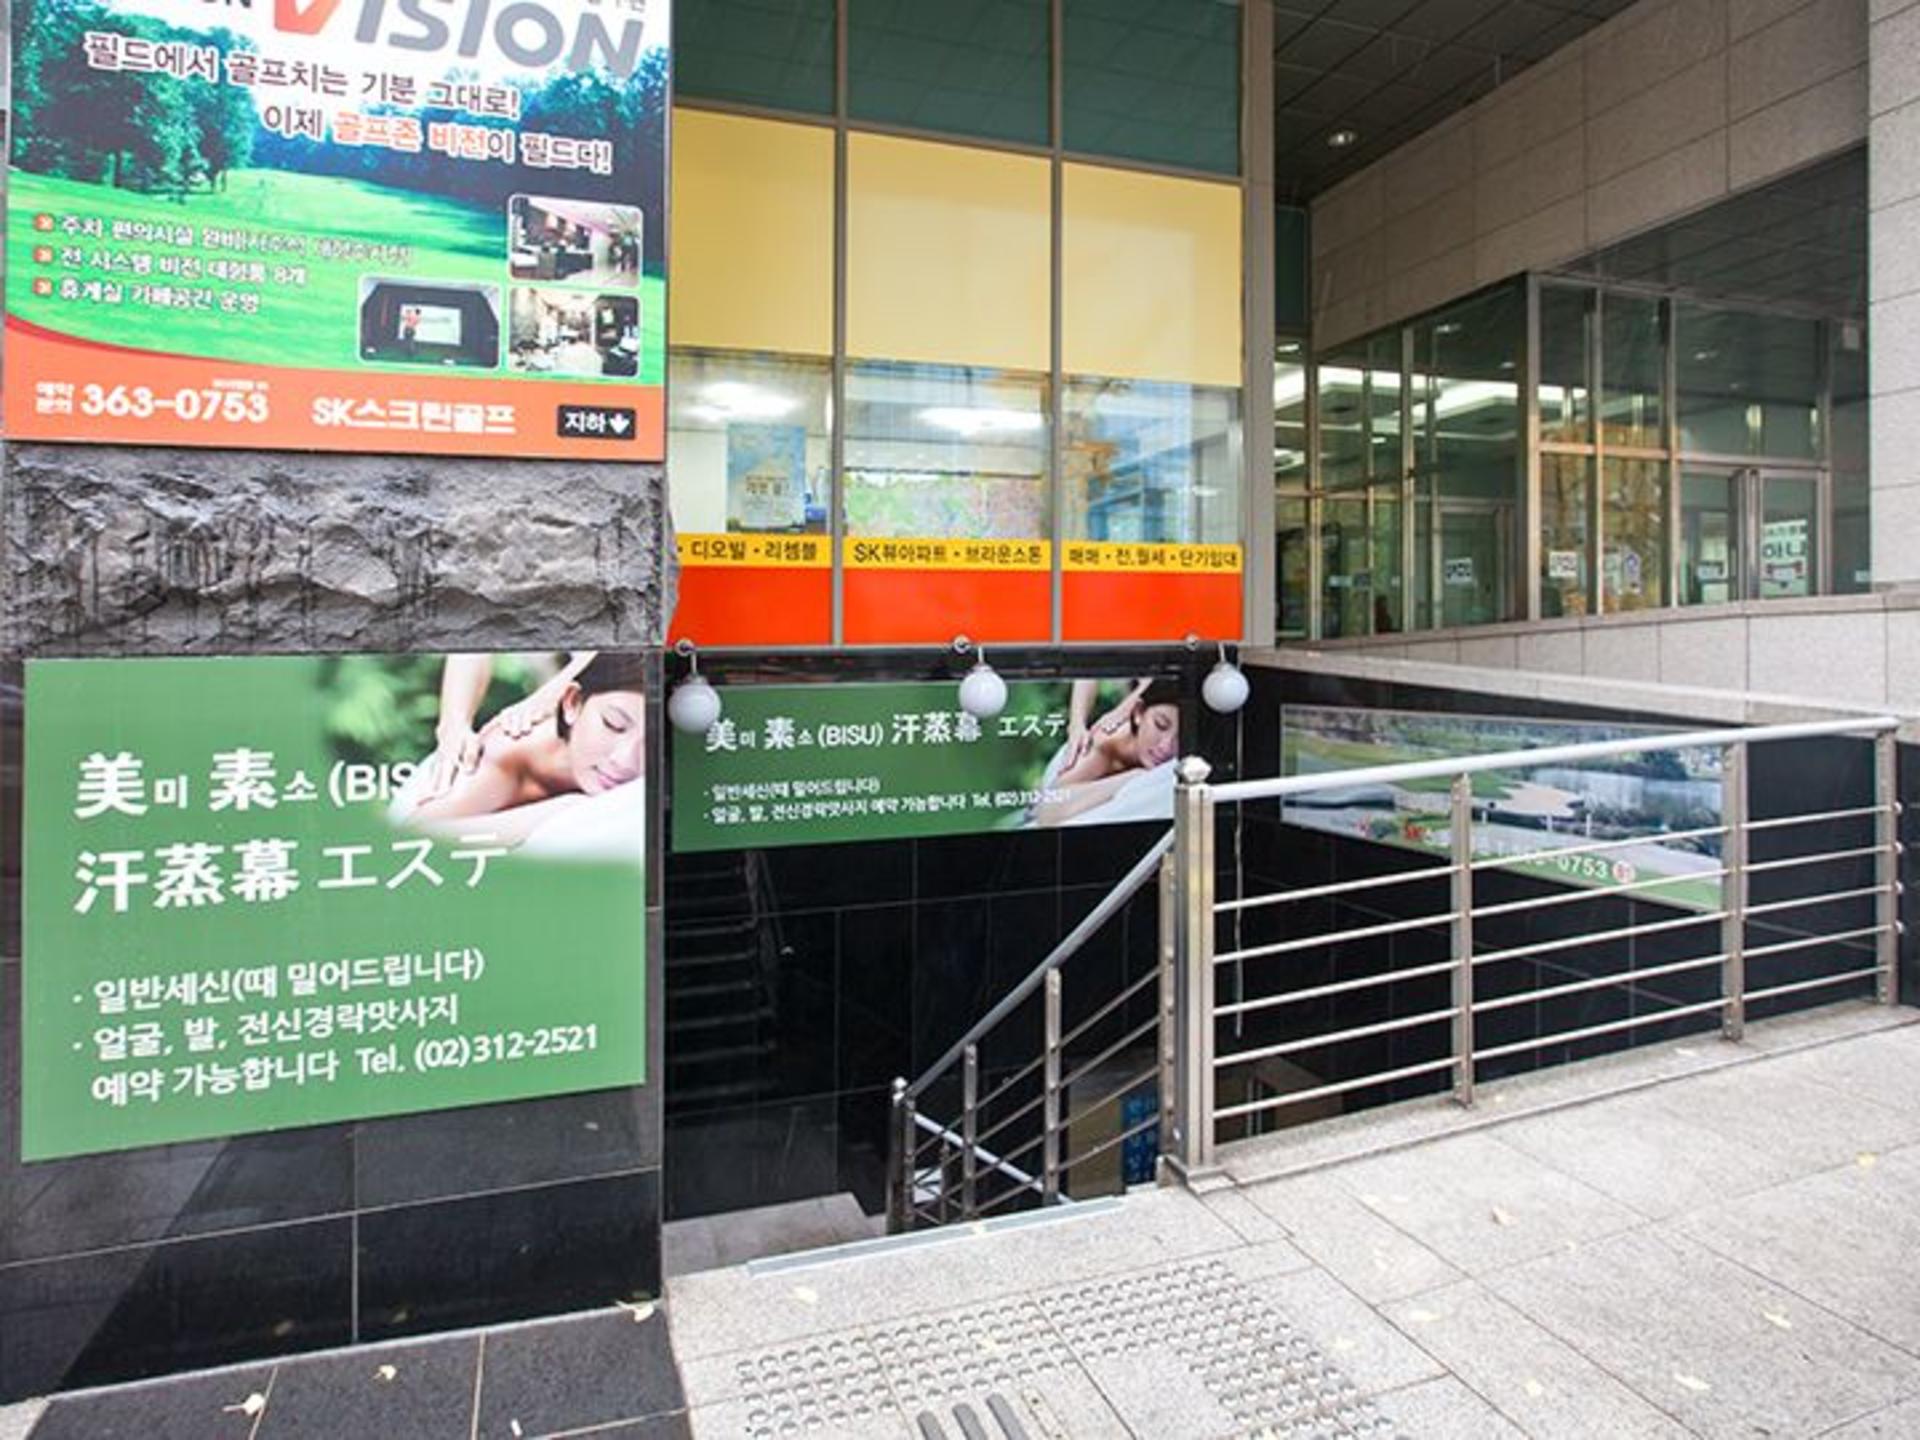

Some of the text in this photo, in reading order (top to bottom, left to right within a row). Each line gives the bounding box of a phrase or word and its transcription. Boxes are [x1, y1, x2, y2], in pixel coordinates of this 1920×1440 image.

[273, 0, 643, 78] VISION
[87, 33, 519, 118] 필드에서 골프치는 기분 그대로!
[263, 105, 610, 172] 이제 골프존 비전이 필드다!
[81, 383, 269, 424] 363-0753
[311, 396, 609, 435] SK스크린골프 지하
[818, 721, 884, 748] (BISU)
[997, 713, 1066, 738] エステ
[73, 832, 509, 915] 汗蒸幕 エステ
[93, 947, 485, 1015] 일반세신(때 밀어드립니다)
[93, 993, 459, 1062] 얼굴, 발, 전신경락맛사지
[91, 1068, 166, 1107] 예약
[171, 1049, 340, 1098] 가능합니다
[354, 1044, 406, 1075] Tel.
